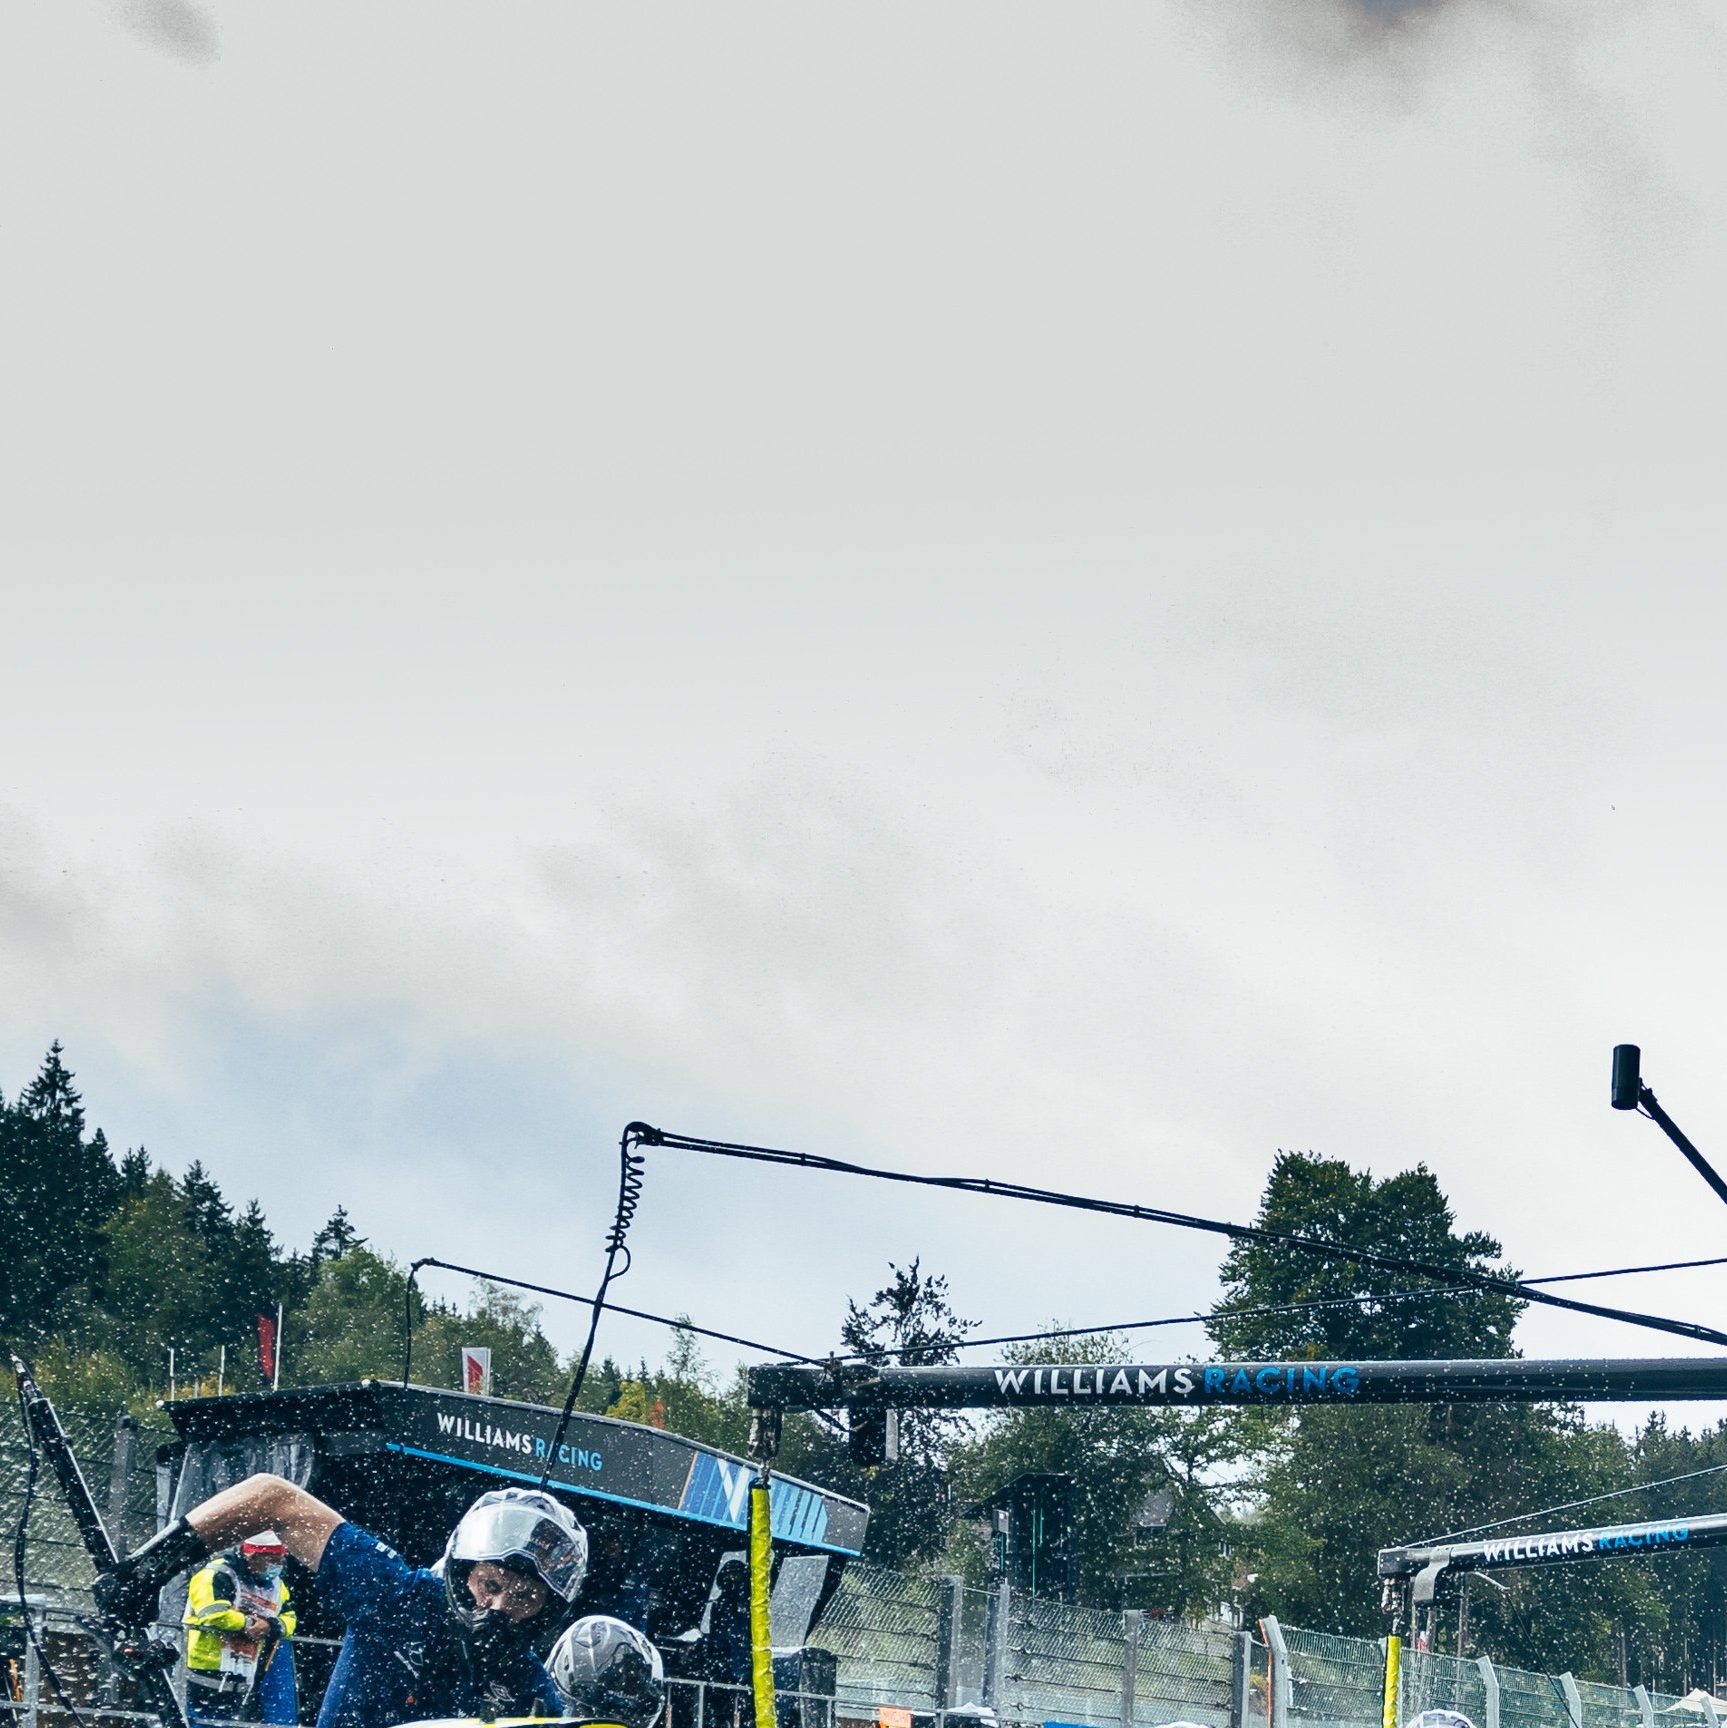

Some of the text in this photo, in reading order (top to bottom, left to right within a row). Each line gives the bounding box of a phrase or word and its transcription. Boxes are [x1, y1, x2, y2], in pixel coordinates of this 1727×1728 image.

[994, 1367, 1359, 1394] WILLIAMS RACING
[437, 1412, 603, 1471] WILLIAMS RCING
[1483, 1521, 1689, 1562] WILLIAMS RACING
